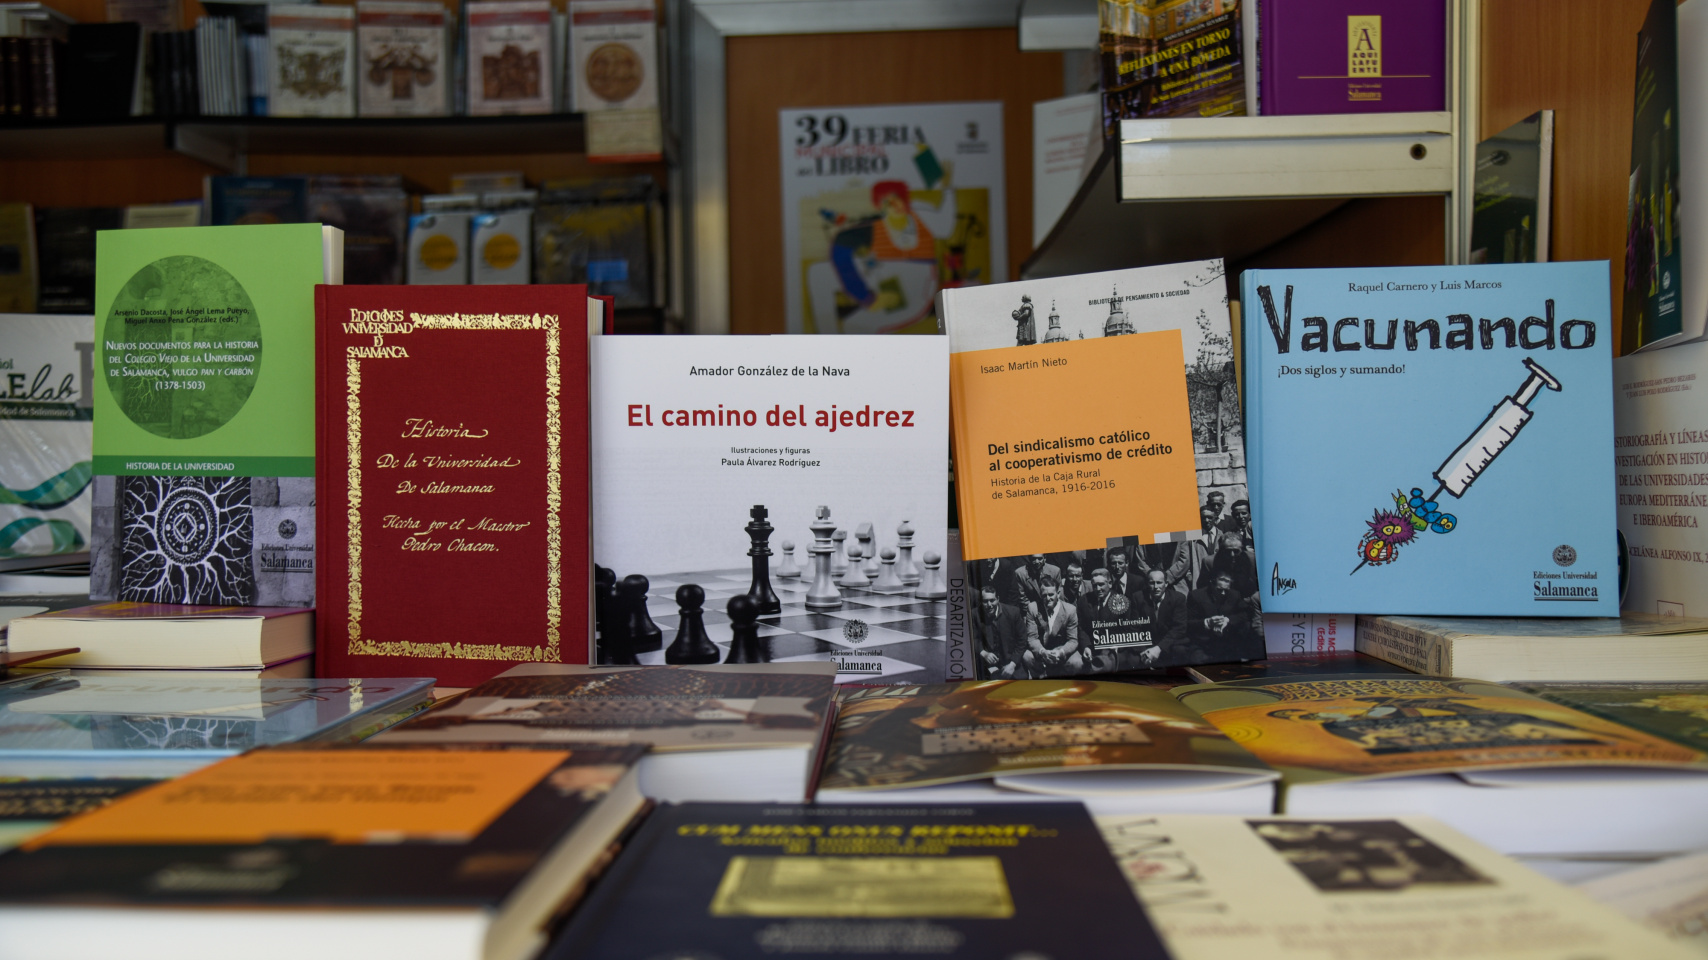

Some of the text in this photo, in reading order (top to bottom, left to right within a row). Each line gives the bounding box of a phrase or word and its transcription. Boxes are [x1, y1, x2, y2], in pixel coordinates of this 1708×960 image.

[1181, 40, 1195, 55] EN
[1196, 27, 1232, 50] TORNO
[1169, 60, 1190, 77] UNA
[1191, 45, 1232, 69] BÓVEDA
[796, 114, 926, 147] 39 FERIA
[815, 155, 889, 176] LIBRO
[1348, 280, 1502, 294] Raquel Carnero y Luis Marcos
[1126, 292, 1160, 302] PENSAMIENTO
[1165, 289, 1190, 298] SOCIEDAD
[114, 306, 250, 318] Arsenio Dacosta, José Ángel Lema Pueyo,
[124, 314, 239, 327] Miguel Anxo Pena González (eds.)
[1257, 285, 1597, 354] Vacunando
[346, 346, 409, 358] SALAMANCA
[690, 365, 850, 376] Amador González de la Nava
[980, 357, 1068, 375] Isaac Martín Nieto
[1277, 364, 1406, 378] ¡Dos siglos y sumando!
[155, 380, 206, 391] (1378-1503)
[628, 404, 915, 433] El camino del ajedrez
[401, 418, 488, 438] Historia
[988, 429, 1151, 455] Del sindicalismo católico
[1669, 433, 1676, 445] Y
[1678, 428, 1708, 445] LÍNEAS
[785, 447, 811, 456] figuras
[989, 443, 1173, 471] al cooperativismo de crédito
[376, 453, 399, 468] De
[404, 452, 418, 468] la
[721, 457, 821, 469] Paula Álvarez Rodríguez
[1667, 453, 1678, 465] EN
[126, 462, 235, 472] HISTORIA DE LA UNIVERSIDAD
[991, 468, 1101, 487] Historia de la Caja Rural
[1619, 473, 1708, 486] DE LAS UNIVERSIDADES
[396, 480, 495, 494] De Salamanca
[992, 480, 1116, 500] de Salamanca, 1916-2016
[1620, 495, 1647, 506] EUROPA
[383, 515, 530, 536] Hecha por el Maestro
[1633, 512, 1698, 528] E IBEROAMÉRICA
[261, 543, 314, 552] Ediciones Universidad
[401, 537, 499, 552] Pedro Chacon.
[260, 553, 313, 571] Salamanca
[1660, 549, 1692, 562] ALFONSO
[1533, 571, 1598, 580] Ediciones Universidad
[1533, 581, 1598, 597] Salamanca
[1092, 616, 1151, 629] Ediciones Universidad
[1292, 621, 1305, 630] Y
[1328, 618, 1336, 635] LUIS
[1092, 629, 1152, 646] Salamanca
[854, 649, 882, 657] Universidad
